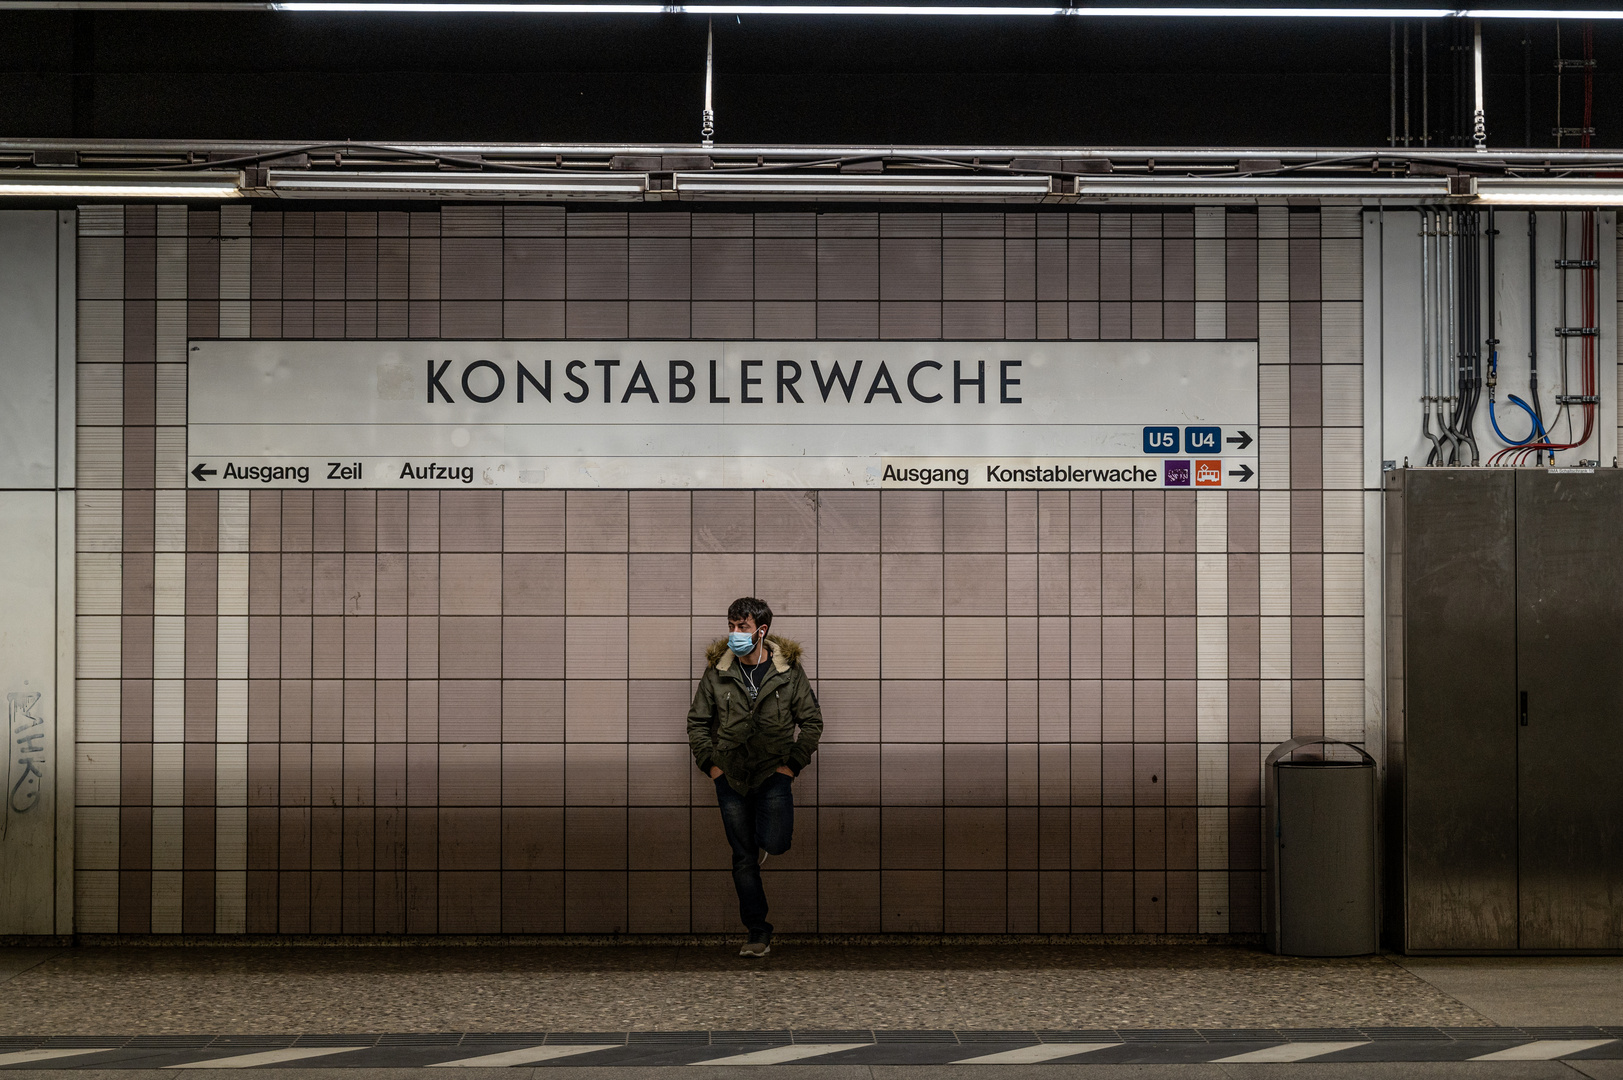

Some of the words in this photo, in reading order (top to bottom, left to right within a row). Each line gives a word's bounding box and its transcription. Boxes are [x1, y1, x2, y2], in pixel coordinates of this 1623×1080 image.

[426, 359, 1023, 404] KONSTABLERWACHE
[1149, 432, 1174, 448] U5
[1191, 432, 1215, 448] U4
[223, 462, 310, 484] Ausgang
[327, 462, 363, 480] Zeil
[400, 462, 474, 484] Aufzug
[882, 464, 969, 486] Ausgang
[986, 465, 1157, 483] Konstablerwache
